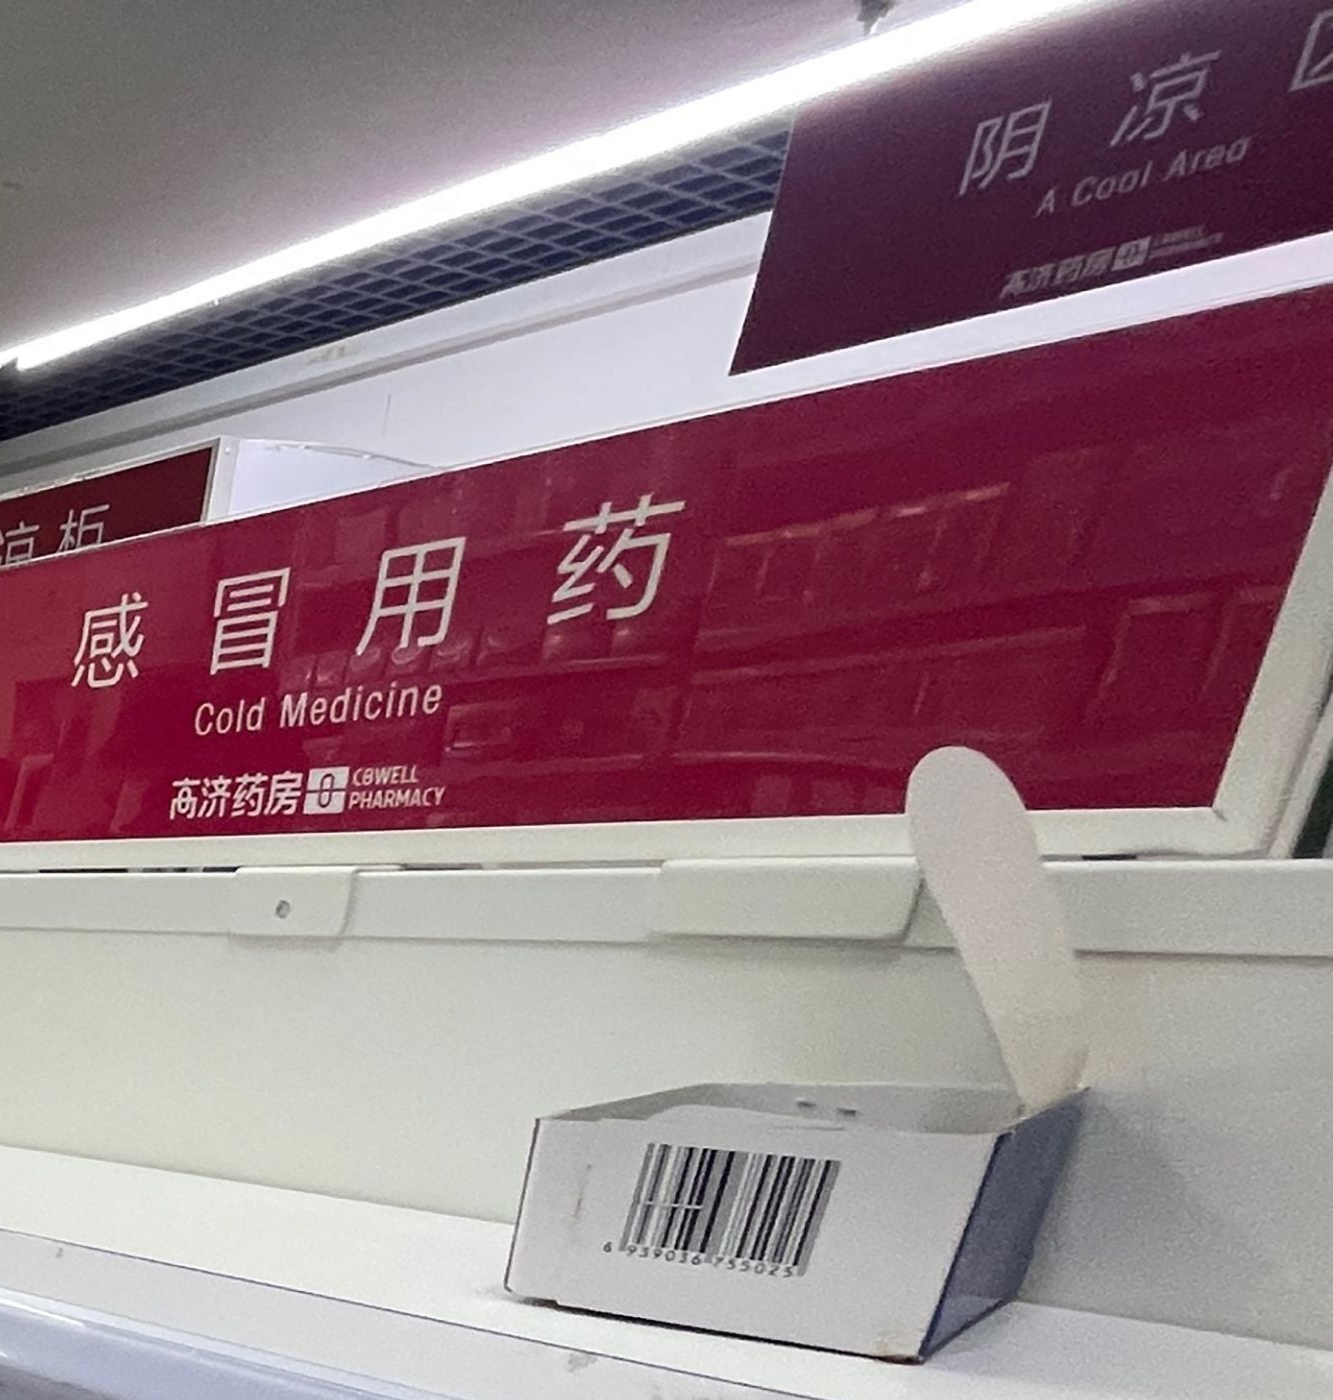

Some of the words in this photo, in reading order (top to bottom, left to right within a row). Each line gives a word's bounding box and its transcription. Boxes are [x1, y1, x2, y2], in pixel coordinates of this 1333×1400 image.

[1036, 188, 1055, 218] A
[1071, 167, 1153, 206] Cool
[1165, 137, 1251, 178] Area
[70, 494, 686, 691] 感冒用药
[194, 698, 265, 736] Cold
[279, 682, 443, 729] Medicine
[169, 772, 303, 820] 高济药房
[347, 786, 446, 810] PHARMACY
